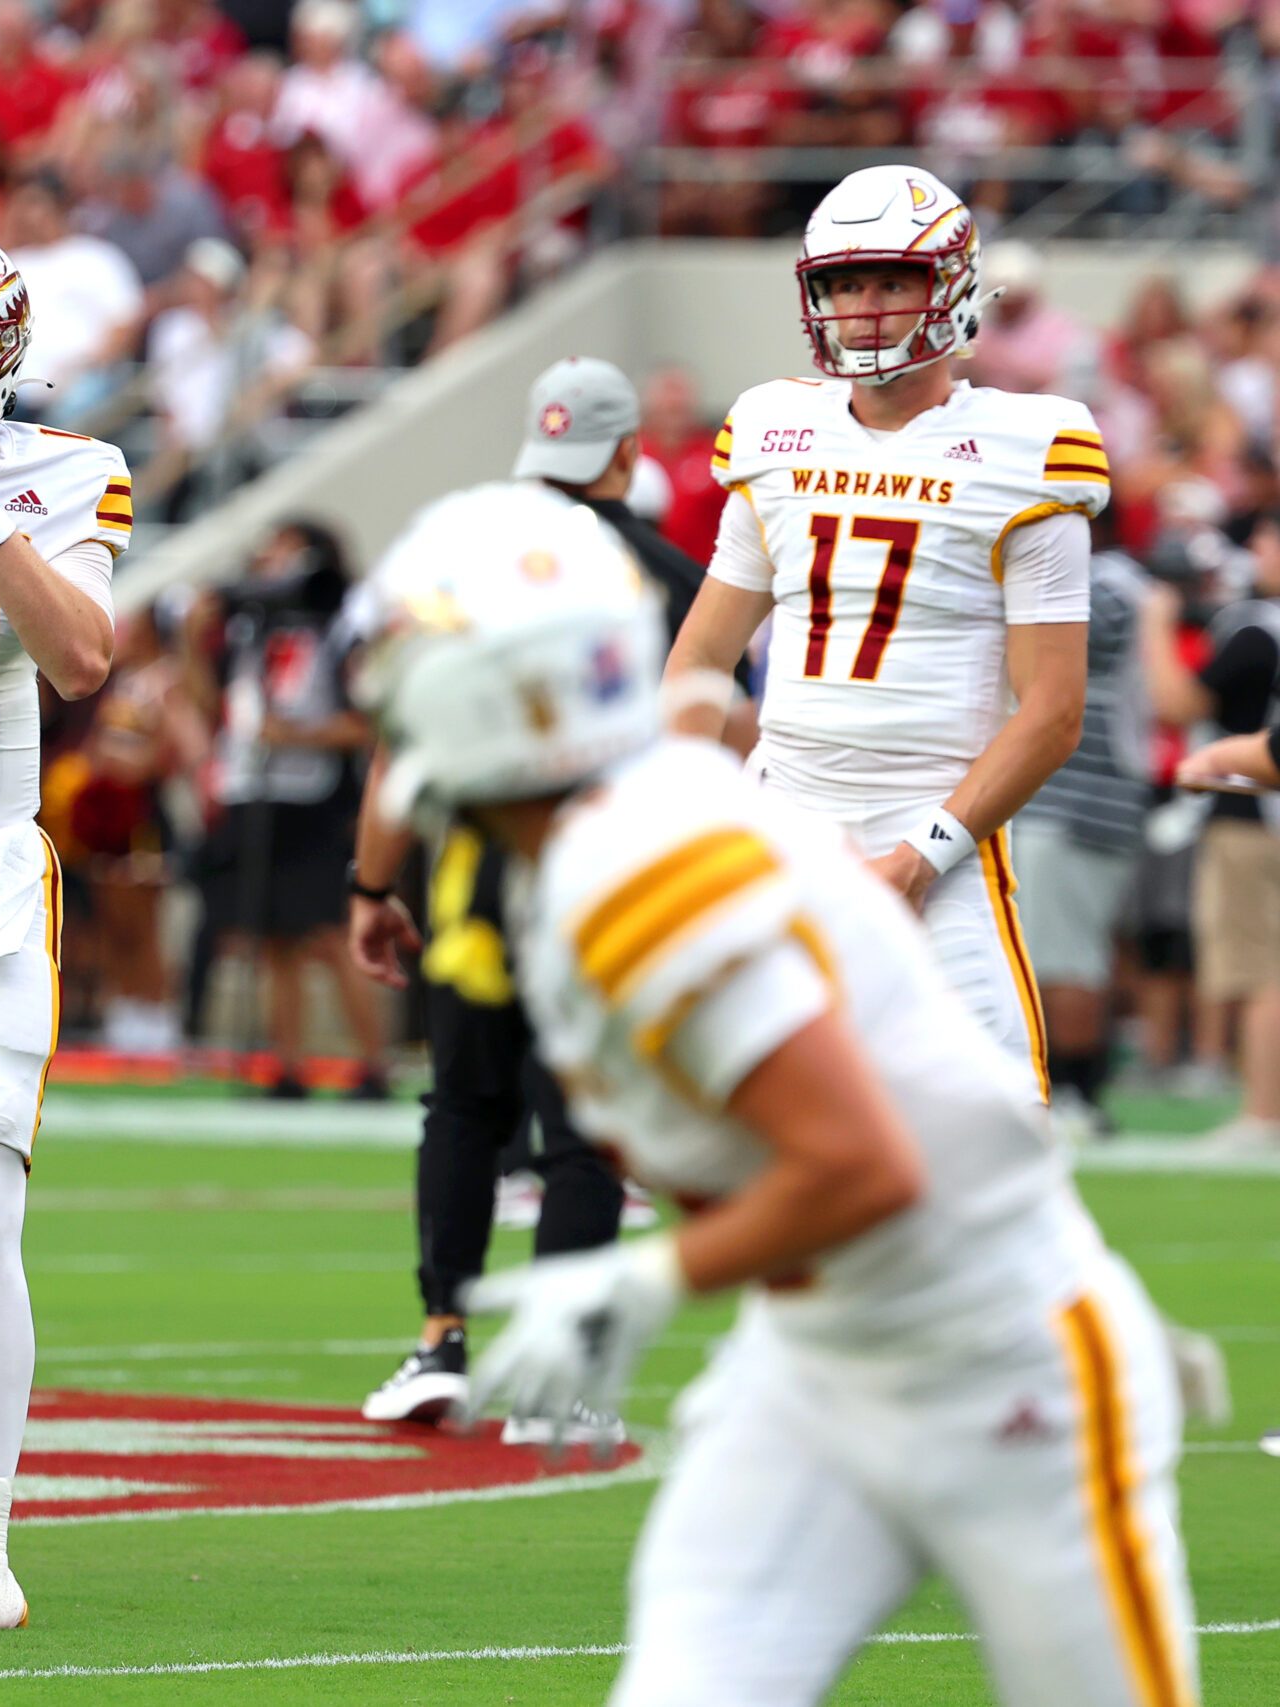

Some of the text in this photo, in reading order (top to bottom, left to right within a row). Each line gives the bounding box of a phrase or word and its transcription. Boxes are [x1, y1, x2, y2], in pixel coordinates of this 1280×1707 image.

[761, 429, 814, 452] SBC
[791, 468, 955, 506] WARHAWKS
[4, 502, 48, 516] adidas
[803, 511, 923, 682] 17
